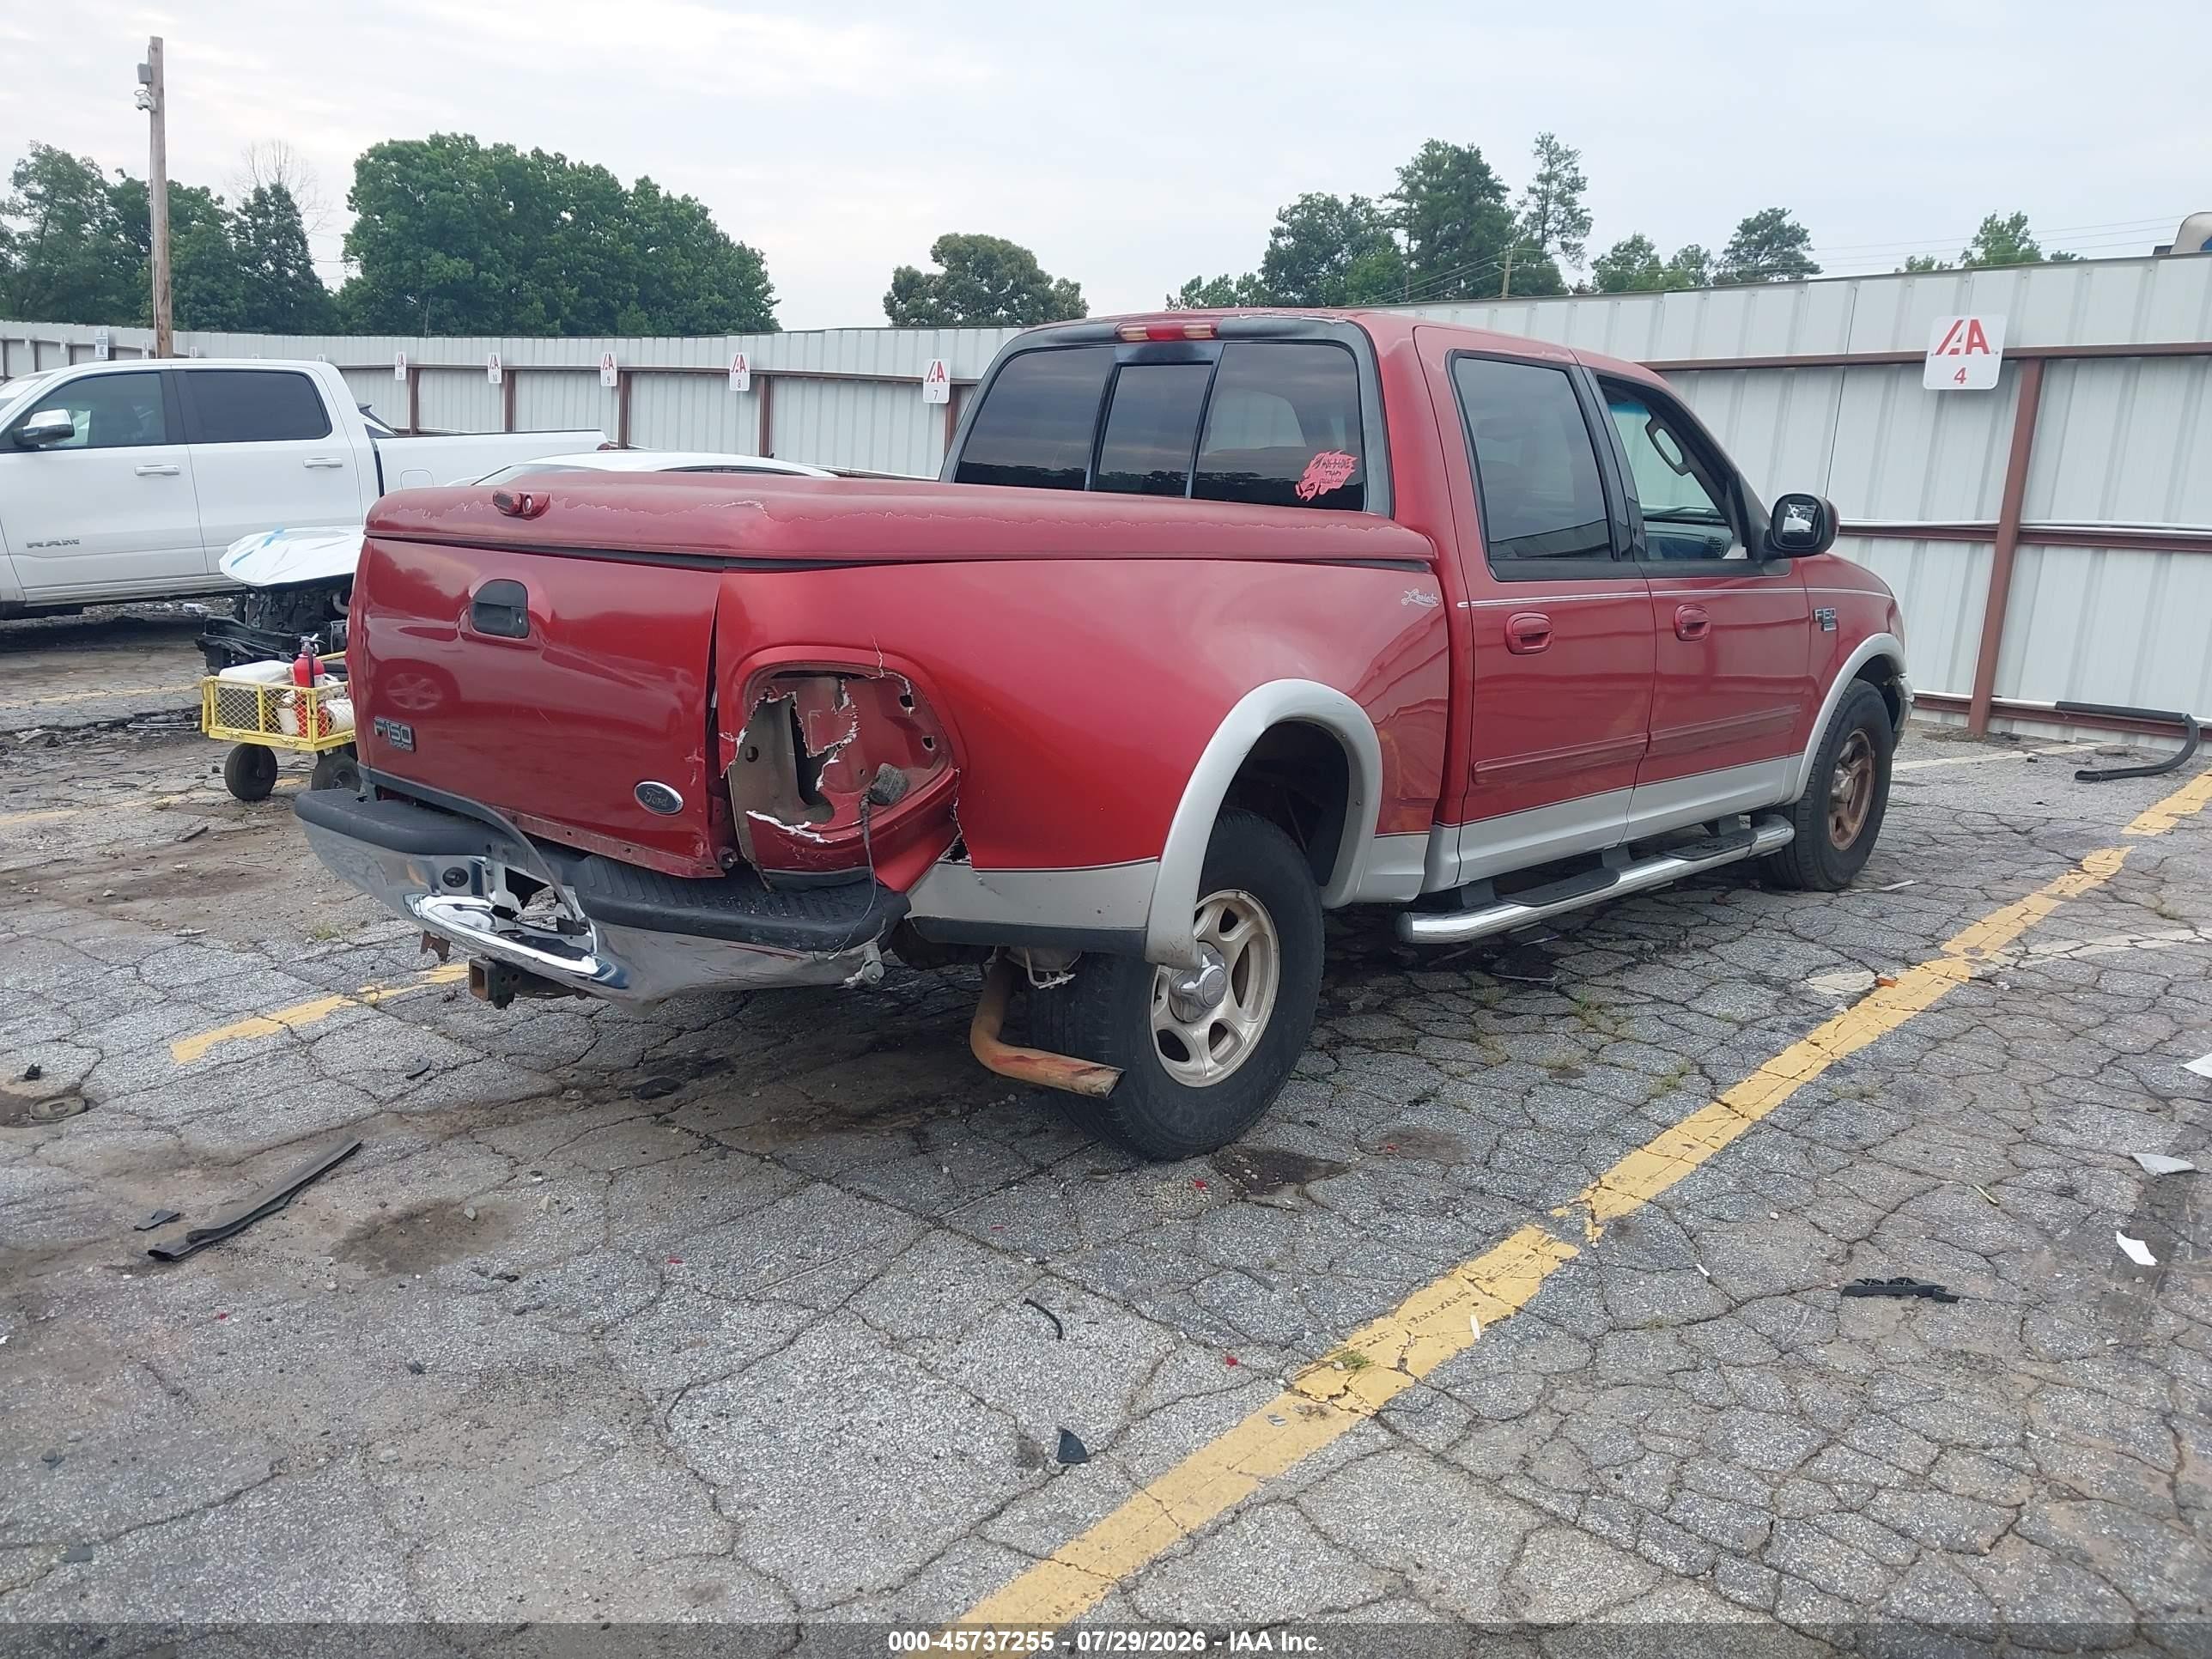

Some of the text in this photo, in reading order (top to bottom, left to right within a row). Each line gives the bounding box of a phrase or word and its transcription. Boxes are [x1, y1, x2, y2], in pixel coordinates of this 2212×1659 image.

[1954, 367, 1966, 384] 4
[933, 389, 939, 400] 7
[26, 538, 80, 548] RAM
[645, 787, 668, 807] Ford
